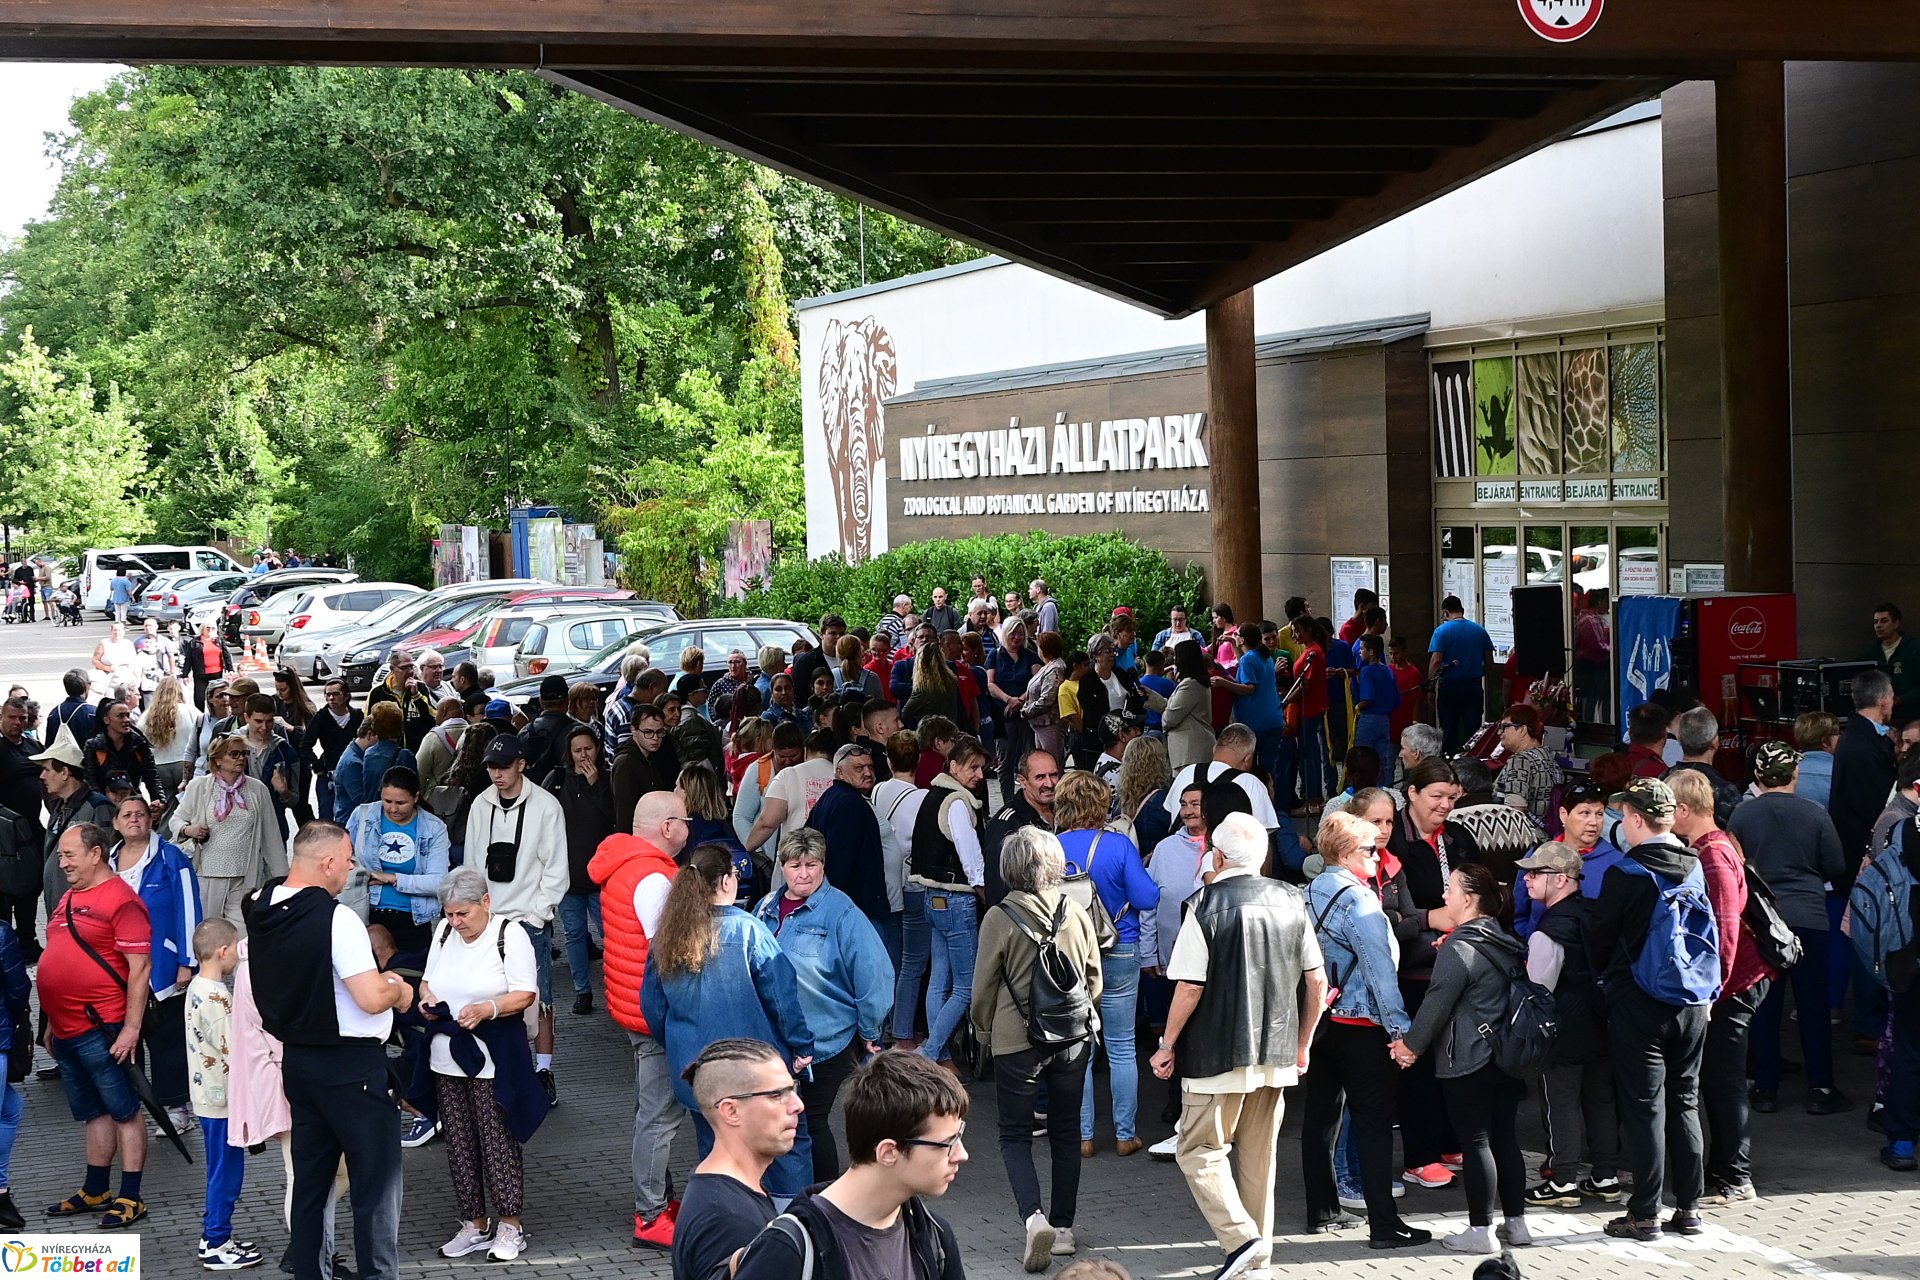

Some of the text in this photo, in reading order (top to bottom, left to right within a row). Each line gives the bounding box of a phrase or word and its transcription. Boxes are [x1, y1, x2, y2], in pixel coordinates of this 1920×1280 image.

[900, 411, 1208, 481] NYÍREGYHÁZI ÁLLATPARK
[1478, 484, 1515, 499] BEJÁRAT
[1520, 485, 1561, 499] ENTRANCE
[1566, 482, 1608, 498] BEJÁRAT
[1613, 483, 1658, 498] ENTRANCE
[904, 484, 1209, 515] ZOOLOGICAL AND BOTANICAL GARDEN OF NYÍREGYHÁZA
